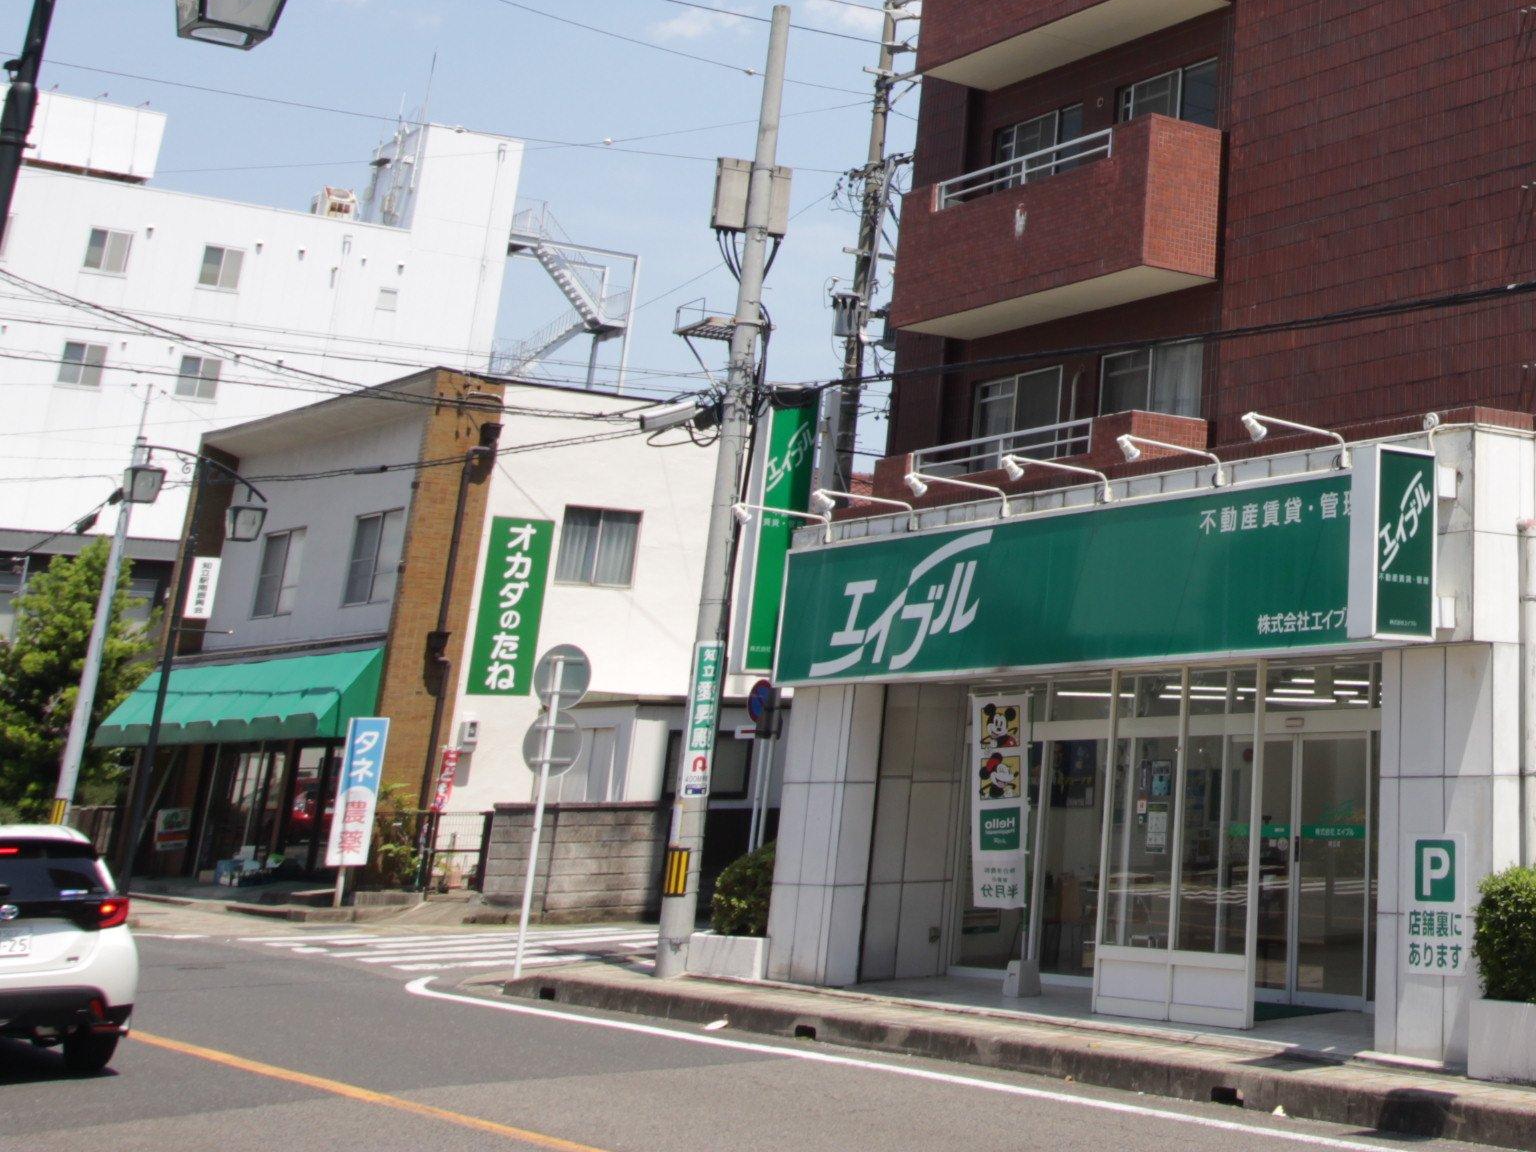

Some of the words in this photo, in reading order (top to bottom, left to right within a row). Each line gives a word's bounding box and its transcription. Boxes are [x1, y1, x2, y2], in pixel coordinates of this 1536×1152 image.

[1379, 471, 1431, 572] エイブル
[485, 523, 537, 690] オカダのたね
[809, 529, 993, 677] エイブル
[350, 730, 380, 783] タネ
[340, 800, 367, 854] 農薬
[1423, 848, 1450, 896] P
[1409, 910, 1462, 937] 店舗裏に
[1409, 942, 1462, 969] あります
